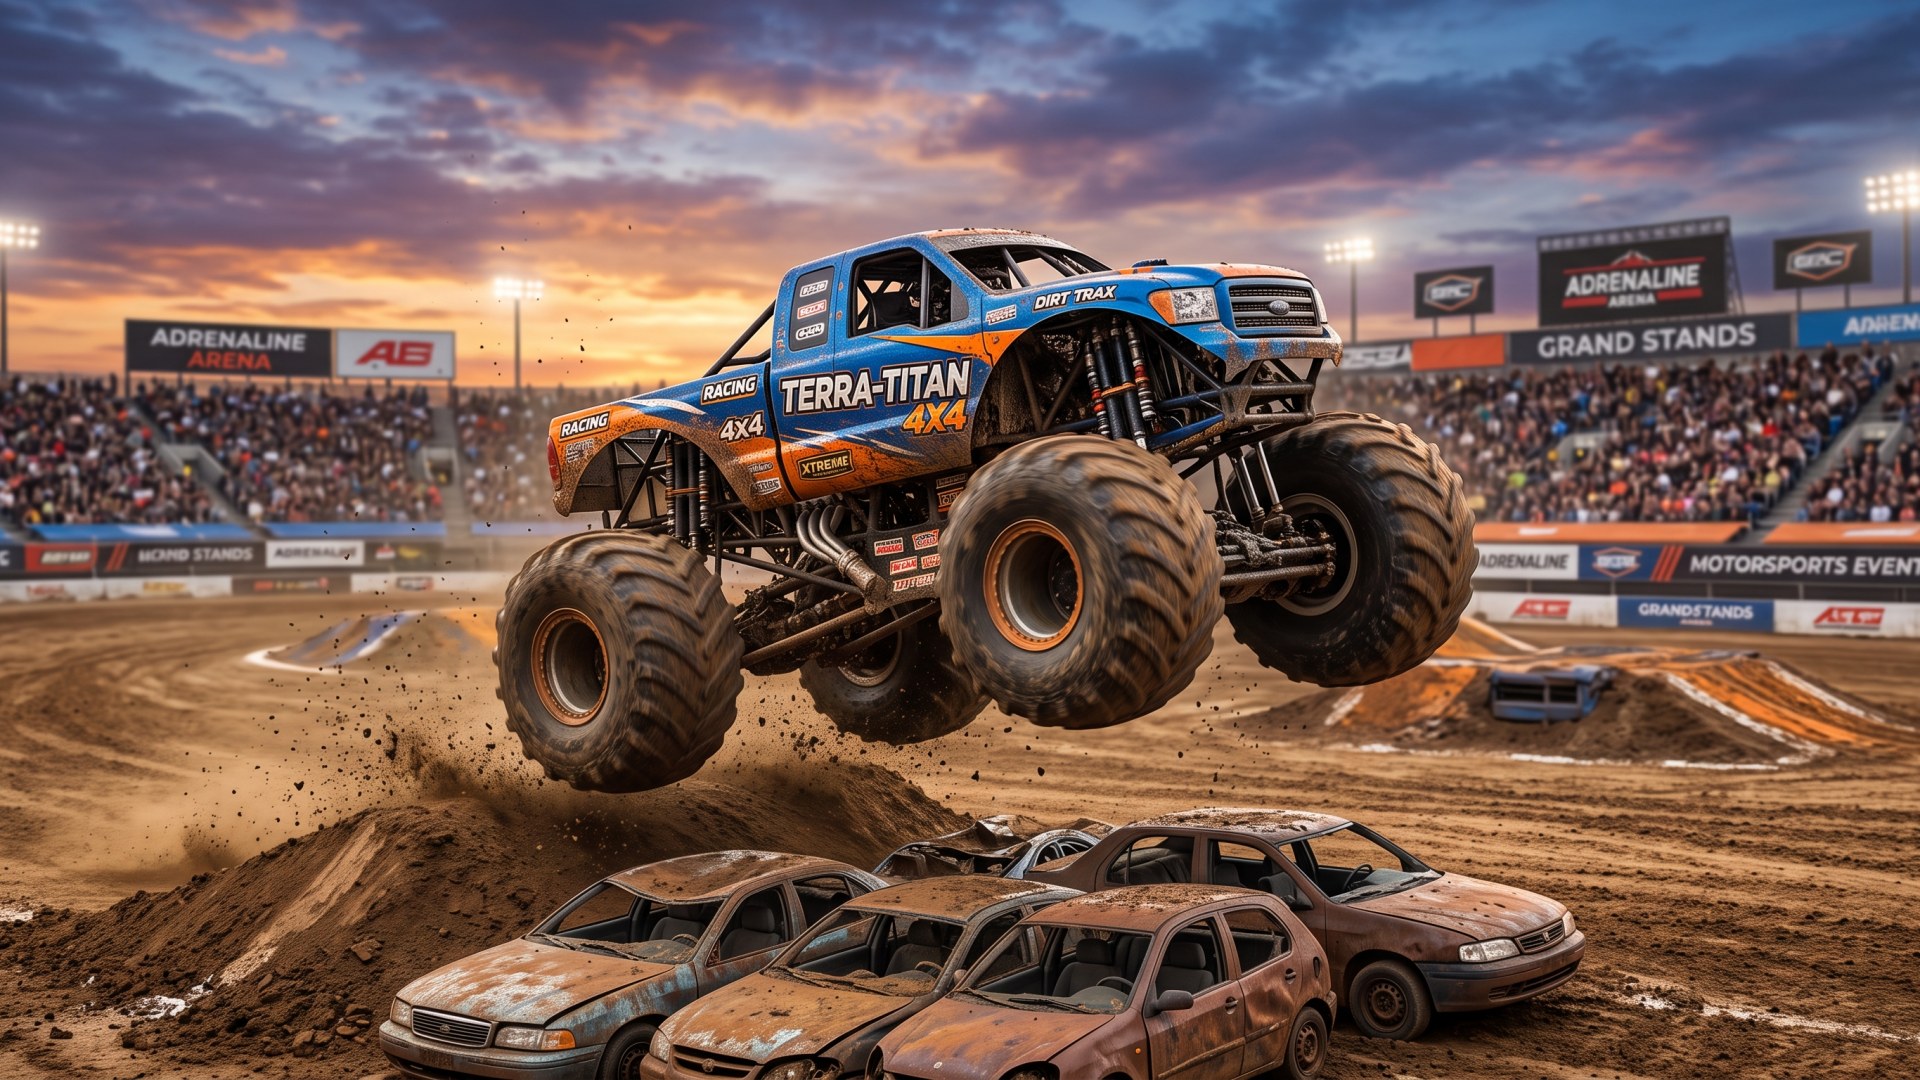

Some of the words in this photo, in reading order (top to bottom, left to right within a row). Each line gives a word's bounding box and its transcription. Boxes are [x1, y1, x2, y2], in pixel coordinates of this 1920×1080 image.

[1564, 263, 1701, 297] ADRENALINE
[1034, 290, 1072, 310] DIRT
[1073, 285, 1117, 303] TRAX
[1608, 292, 1656, 309] ARENA
[151, 327, 307, 353] ADRENALINE
[1538, 331, 1635, 359] GRAND
[1642, 322, 1757, 353] STANDS
[187, 351, 271, 371] ARENA
[703, 376, 757, 401] RACING
[780, 359, 972, 415] TERRA-TITAN
[561, 412, 609, 438] RACING
[193, 547, 254, 561] STANDS
[1480, 553, 1569, 570] ADRENALINE
[1689, 554, 1848, 575] MOTORSPORTS
